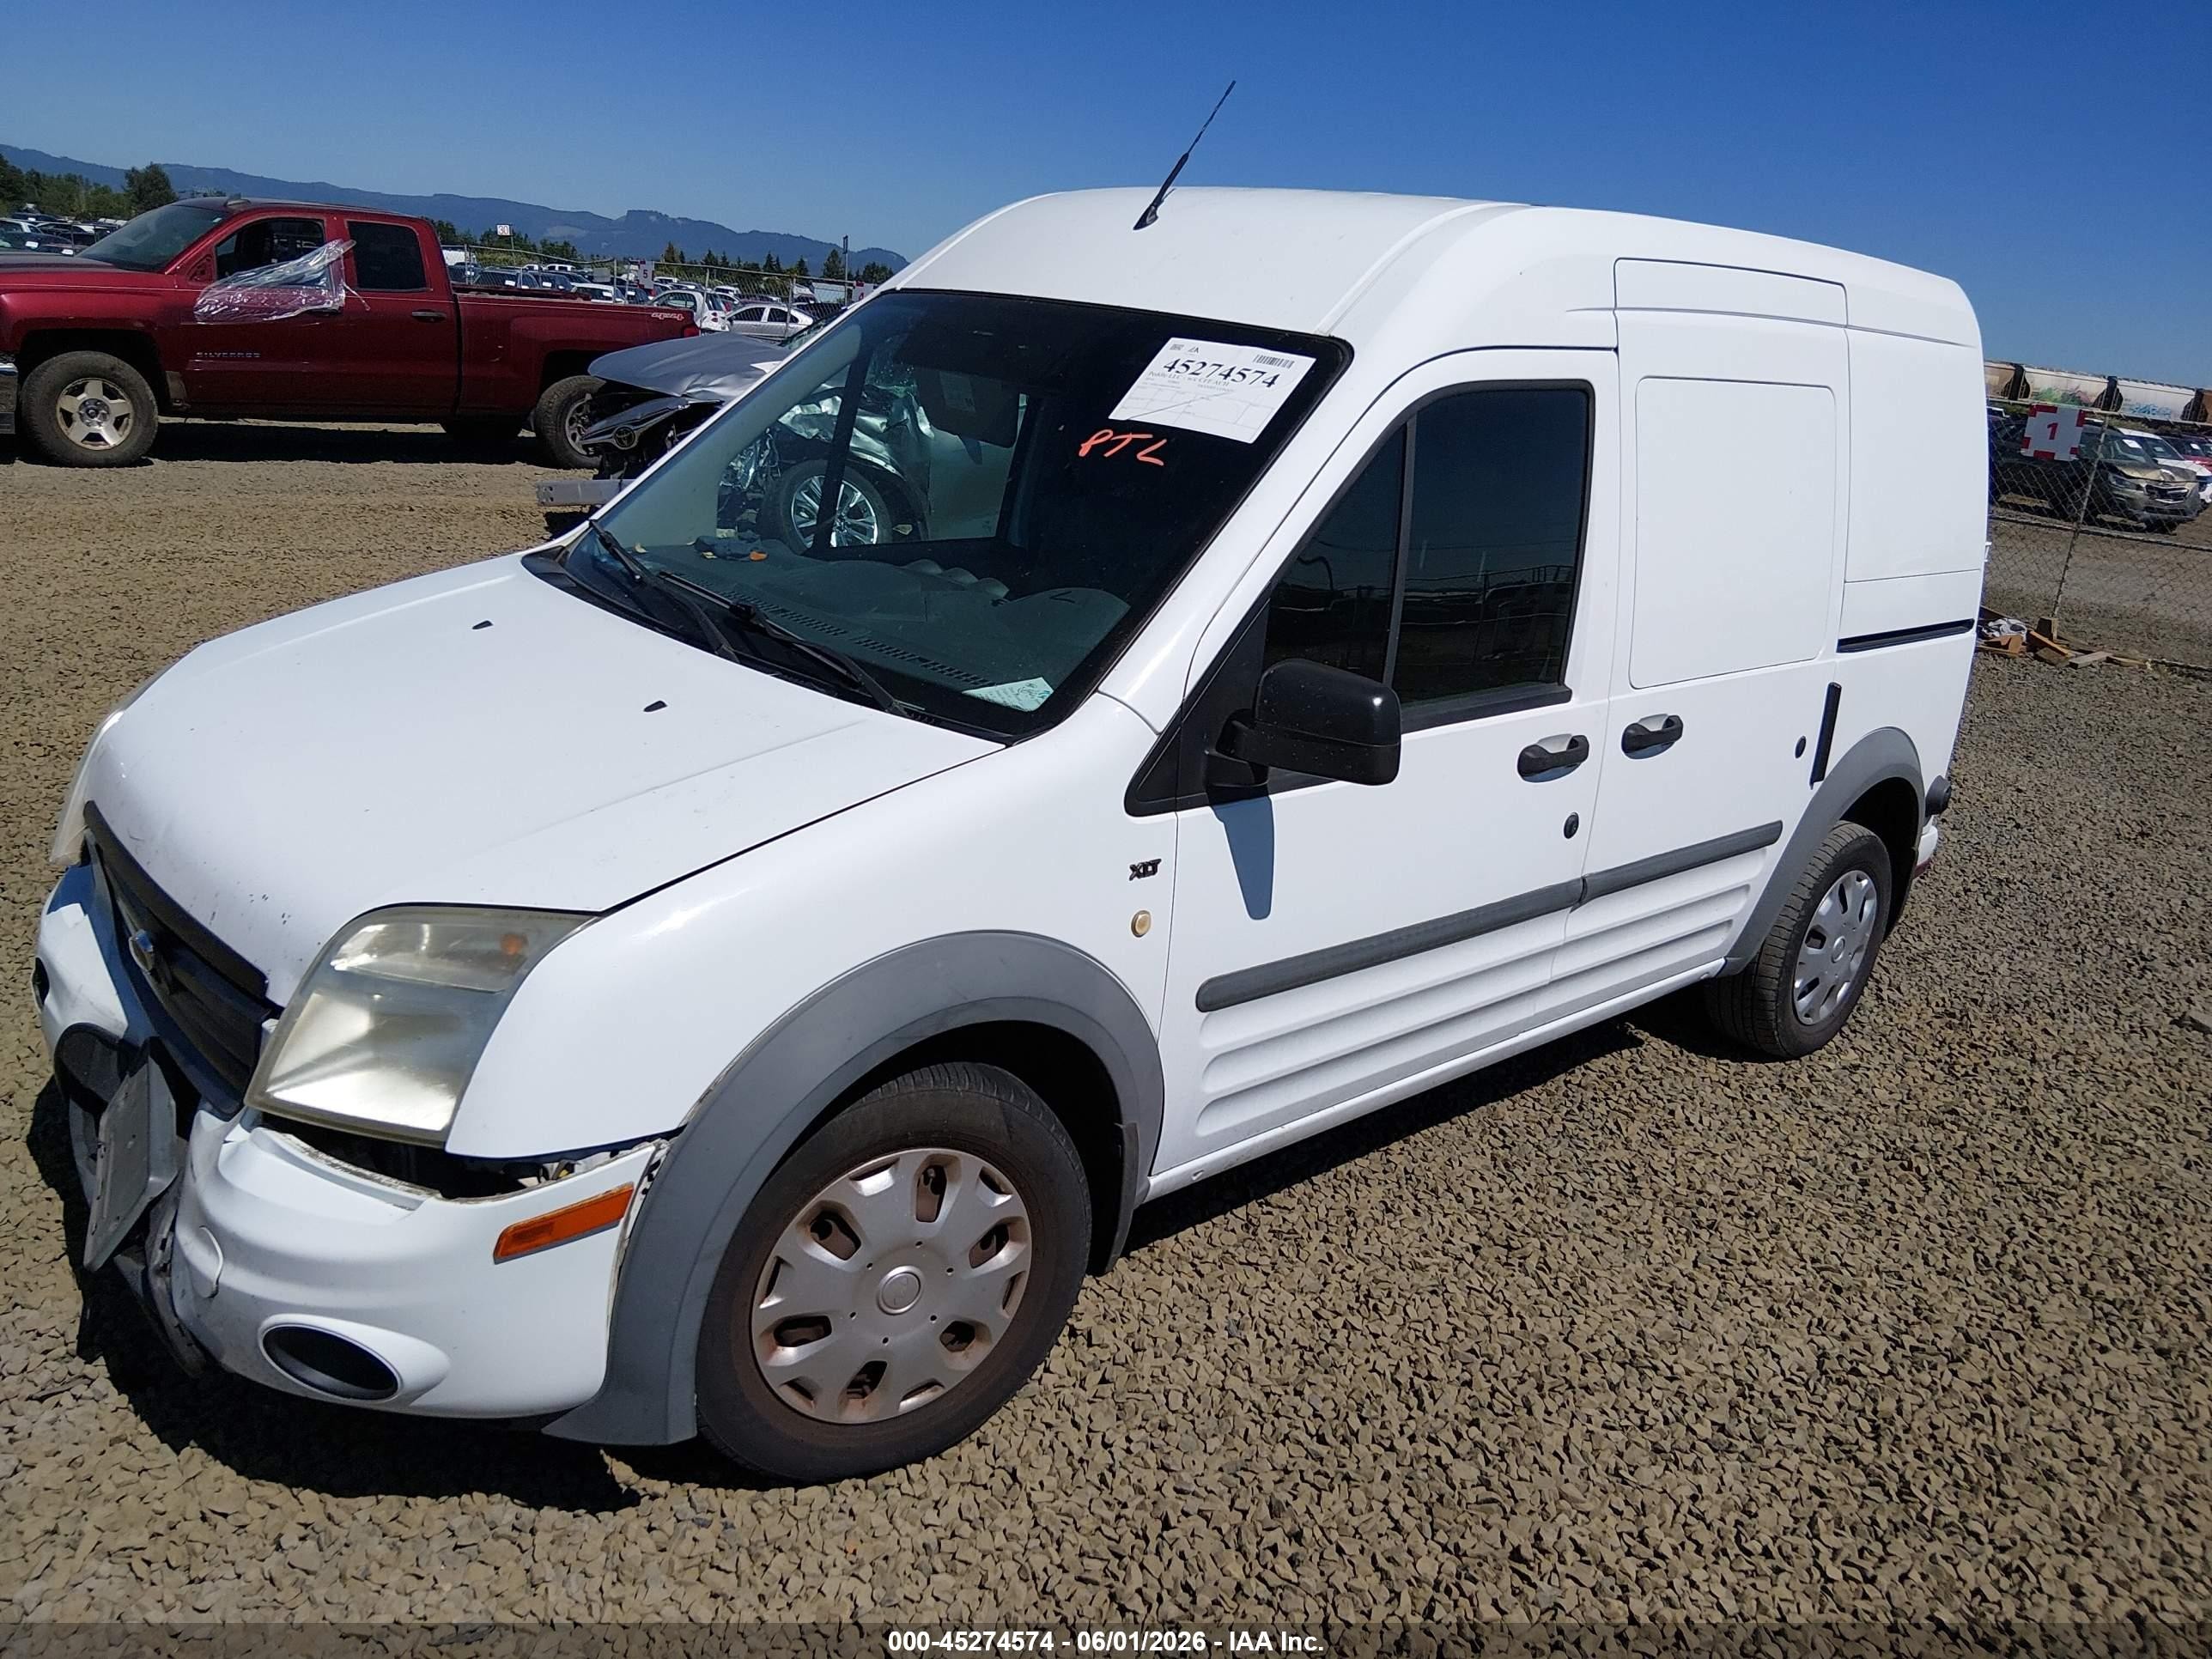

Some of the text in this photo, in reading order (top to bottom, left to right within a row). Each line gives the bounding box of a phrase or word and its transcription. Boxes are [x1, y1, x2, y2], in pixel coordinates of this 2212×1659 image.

[499, 226, 508, 234] 30
[643, 270, 647, 278] 5
[1164, 358, 1280, 388] 45274574
[2047, 422, 2058, 440] 1
[1079, 429, 1167, 466] PTL
